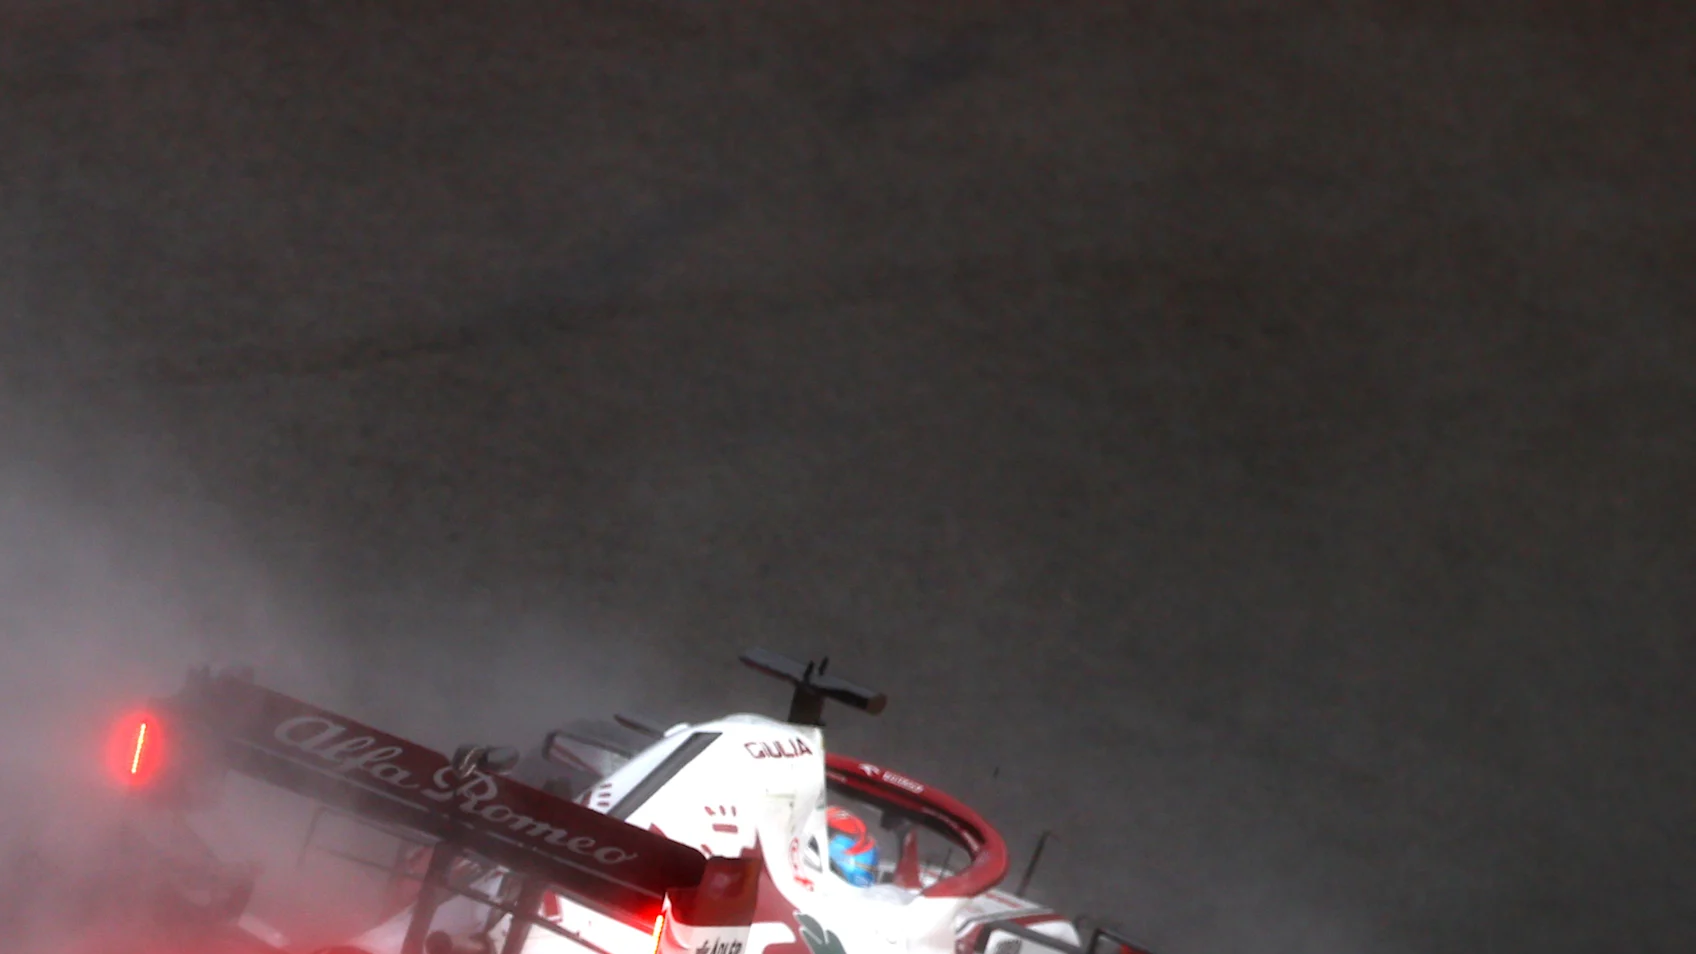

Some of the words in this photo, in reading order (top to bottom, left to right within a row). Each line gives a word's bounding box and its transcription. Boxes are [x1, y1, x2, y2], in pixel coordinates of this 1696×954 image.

[274, 715, 420, 790] Alfa
[421, 763, 638, 864] Romeo
[744, 736, 813, 759] GIULIA
